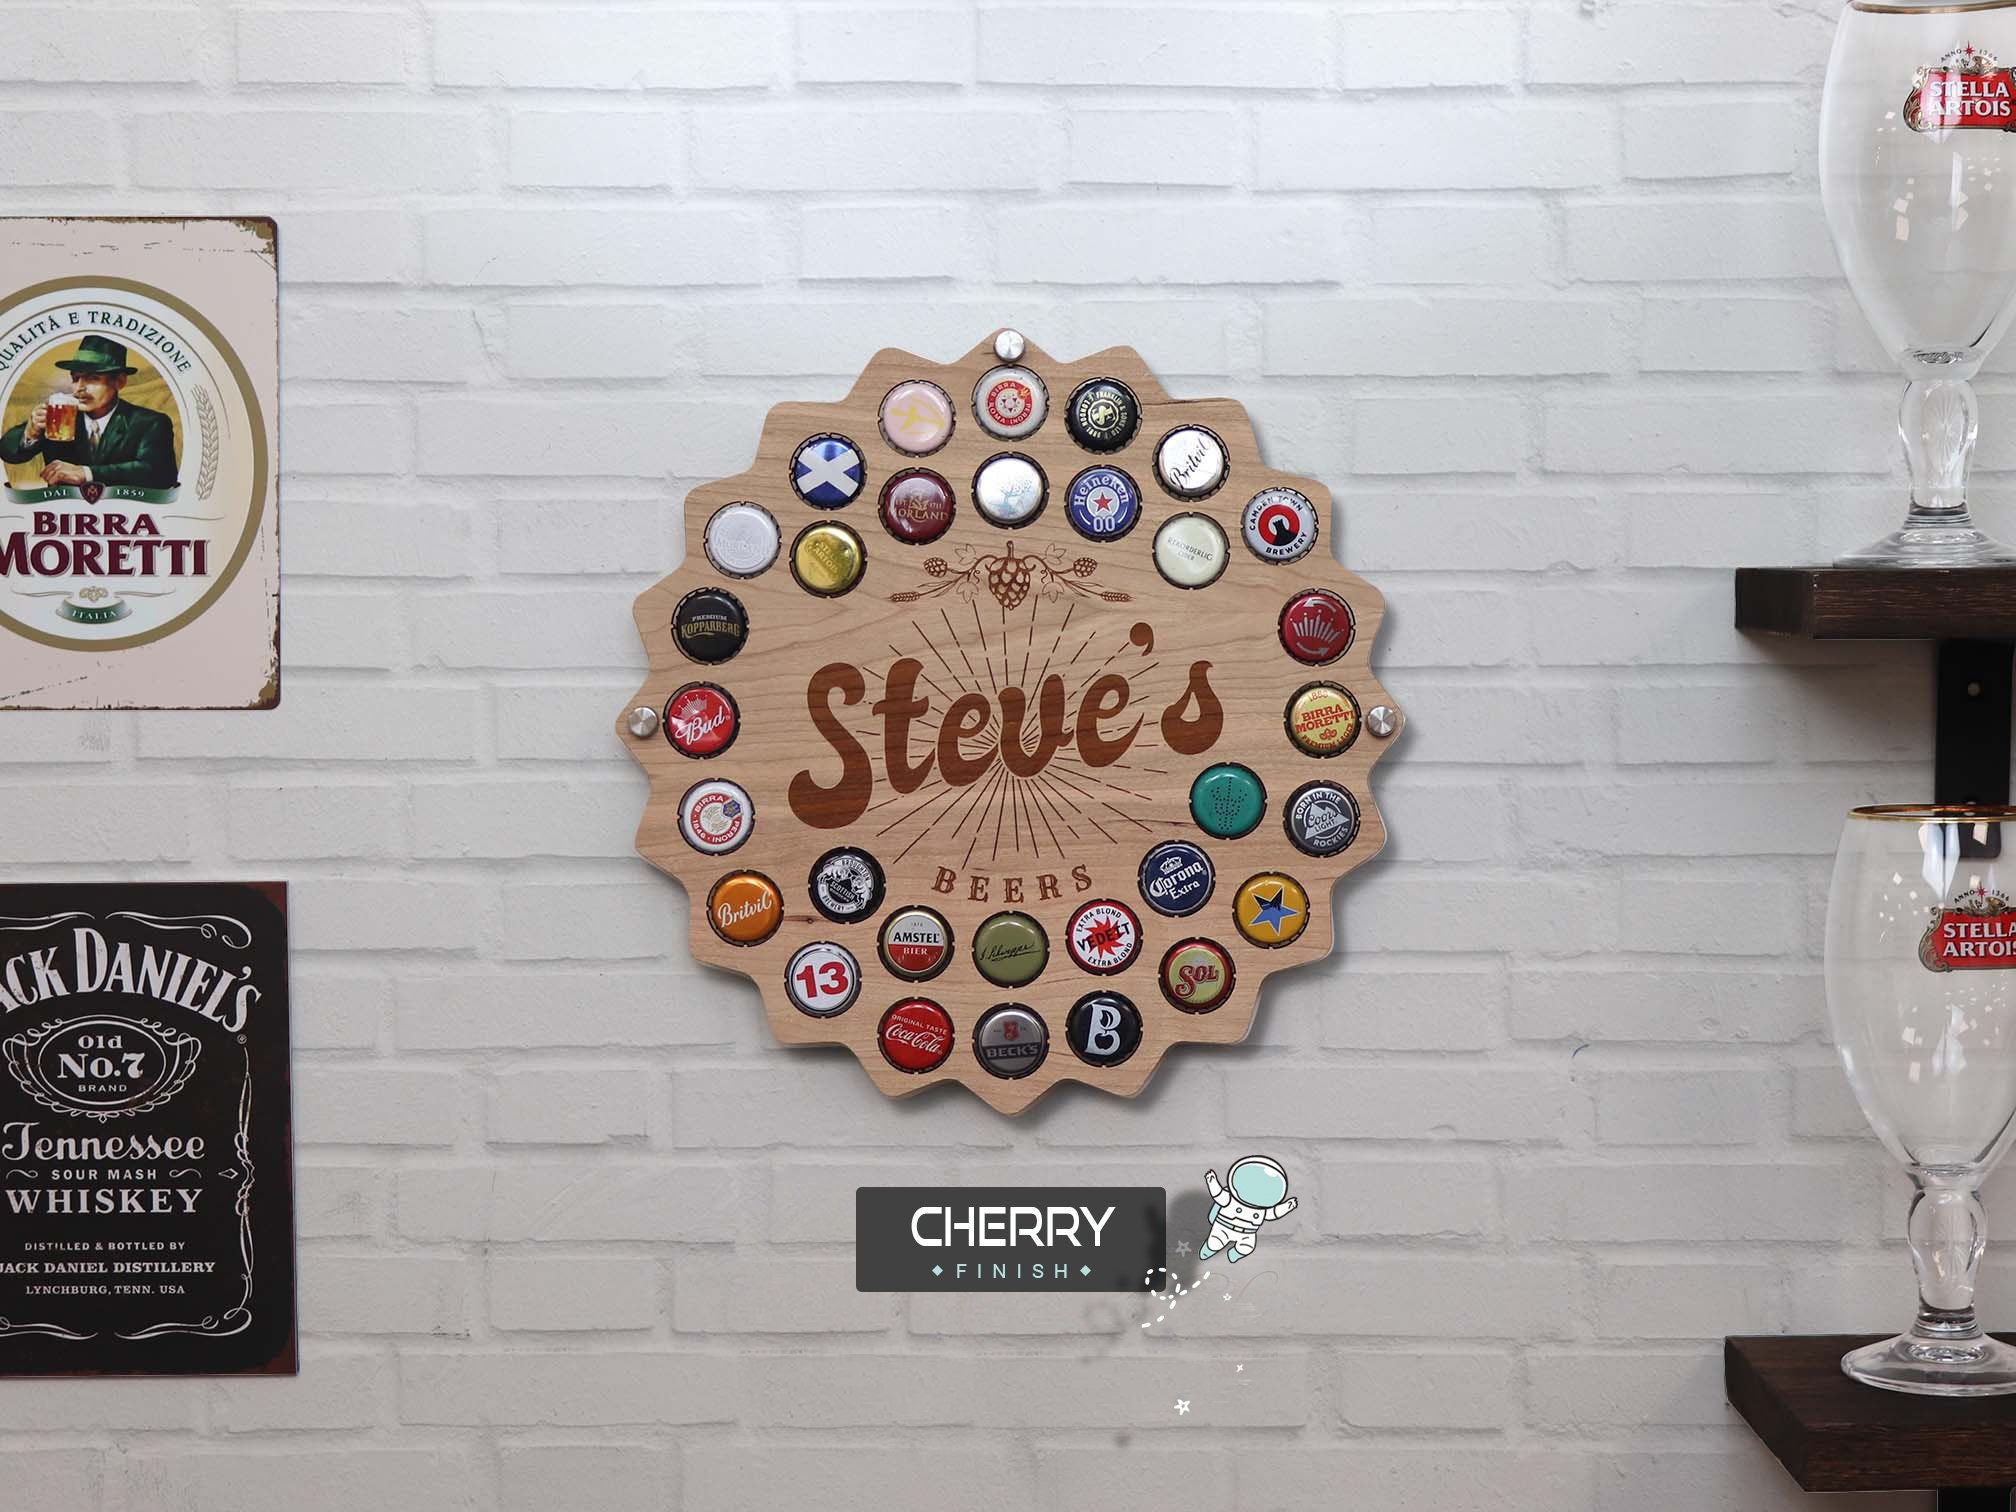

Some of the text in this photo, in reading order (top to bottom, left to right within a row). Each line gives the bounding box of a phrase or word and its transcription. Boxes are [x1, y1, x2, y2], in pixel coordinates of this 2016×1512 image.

[1929, 81, 2010, 97] STELLA
[1928, 100, 2011, 117] ARTOIS
[68, 312, 80, 325] E
[88, 311, 192, 373] TRADIZIONE
[991, 382, 1016, 398] BIRRA
[1010, 403, 1031, 425] PERONI
[1074, 475, 1129, 506] Heineken
[896, 508, 949, 521] ORLAND
[1250, 496, 1274, 530] CAMDEN
[33, 511, 162, 537] BIRRA
[1265, 531, 1307, 555] BREWERY
[0, 531, 210, 577] MORETTI
[692, 614, 728, 622] PREMIUM
[681, 620, 740, 638] KOPPARBERG
[1295, 710, 1355, 735] MORETTI
[1301, 704, 1344, 721] BIRRA
[675, 705, 725, 745] Bud
[788, 621, 1225, 830] Steve's
[694, 795, 724, 813] BIRRA
[1295, 791, 1341, 819] BORN IN THE
[712, 820, 740, 843] PERONI
[1313, 826, 1348, 847] ROCKIES
[1314, 819, 1335, 833] LIGHT
[931, 864, 1093, 904] BEERS
[1150, 861, 1203, 897] Corona
[1168, 880, 1200, 900] Extra
[1954, 889, 1976, 904] ANNO
[1076, 907, 1122, 932] EXTRA BLOND
[893, 931, 940, 944] AMSTEL
[903, 947, 928, 955] BIER
[1087, 942, 1133, 967] EXTRA BLOND
[1943, 941, 2016, 957] ARTOI
[72, 927, 262, 1033] DANIEL'S
[796, 961, 849, 999] 13
[892, 1014, 948, 1036] ORIGINAL TASTE
[78, 1035, 123, 1049] Old
[78, 1084, 127, 1093] BRAND
[2, 1121, 206, 1161] Tennessee
[51, 1169, 157, 1180] SOUR MASH
[6, 1188, 203, 1214] WHISKEY
[25, 1242, 185, 1250] DISTILLED & BOTTLED BY
[0, 1262, 215, 1273] JACK DANIEL DISTILLERY
[26, 1285, 185, 1296] LYNCHBURG, TENN. USA
